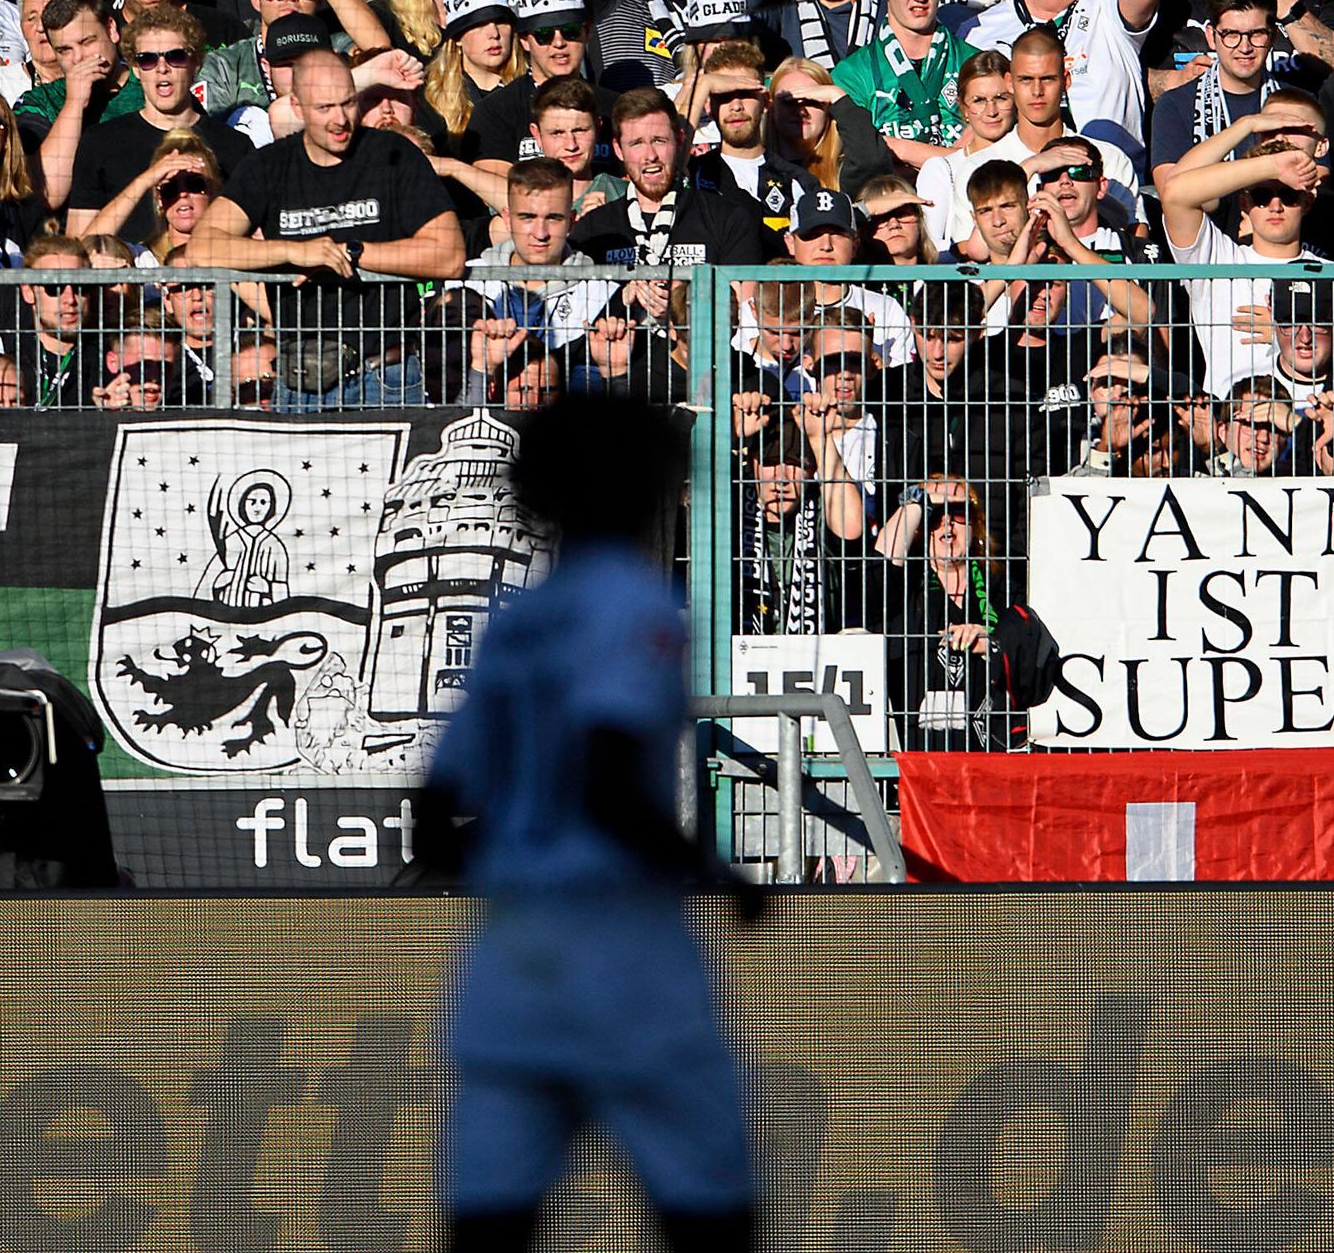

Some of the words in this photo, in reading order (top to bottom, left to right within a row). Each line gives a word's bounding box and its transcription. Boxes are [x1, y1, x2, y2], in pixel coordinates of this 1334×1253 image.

[276, 34, 320, 47] BORUSSIA
[815, 191, 835, 212] B
[279, 203, 318, 228] SEIT
[1147, 567, 1319, 655] IST
